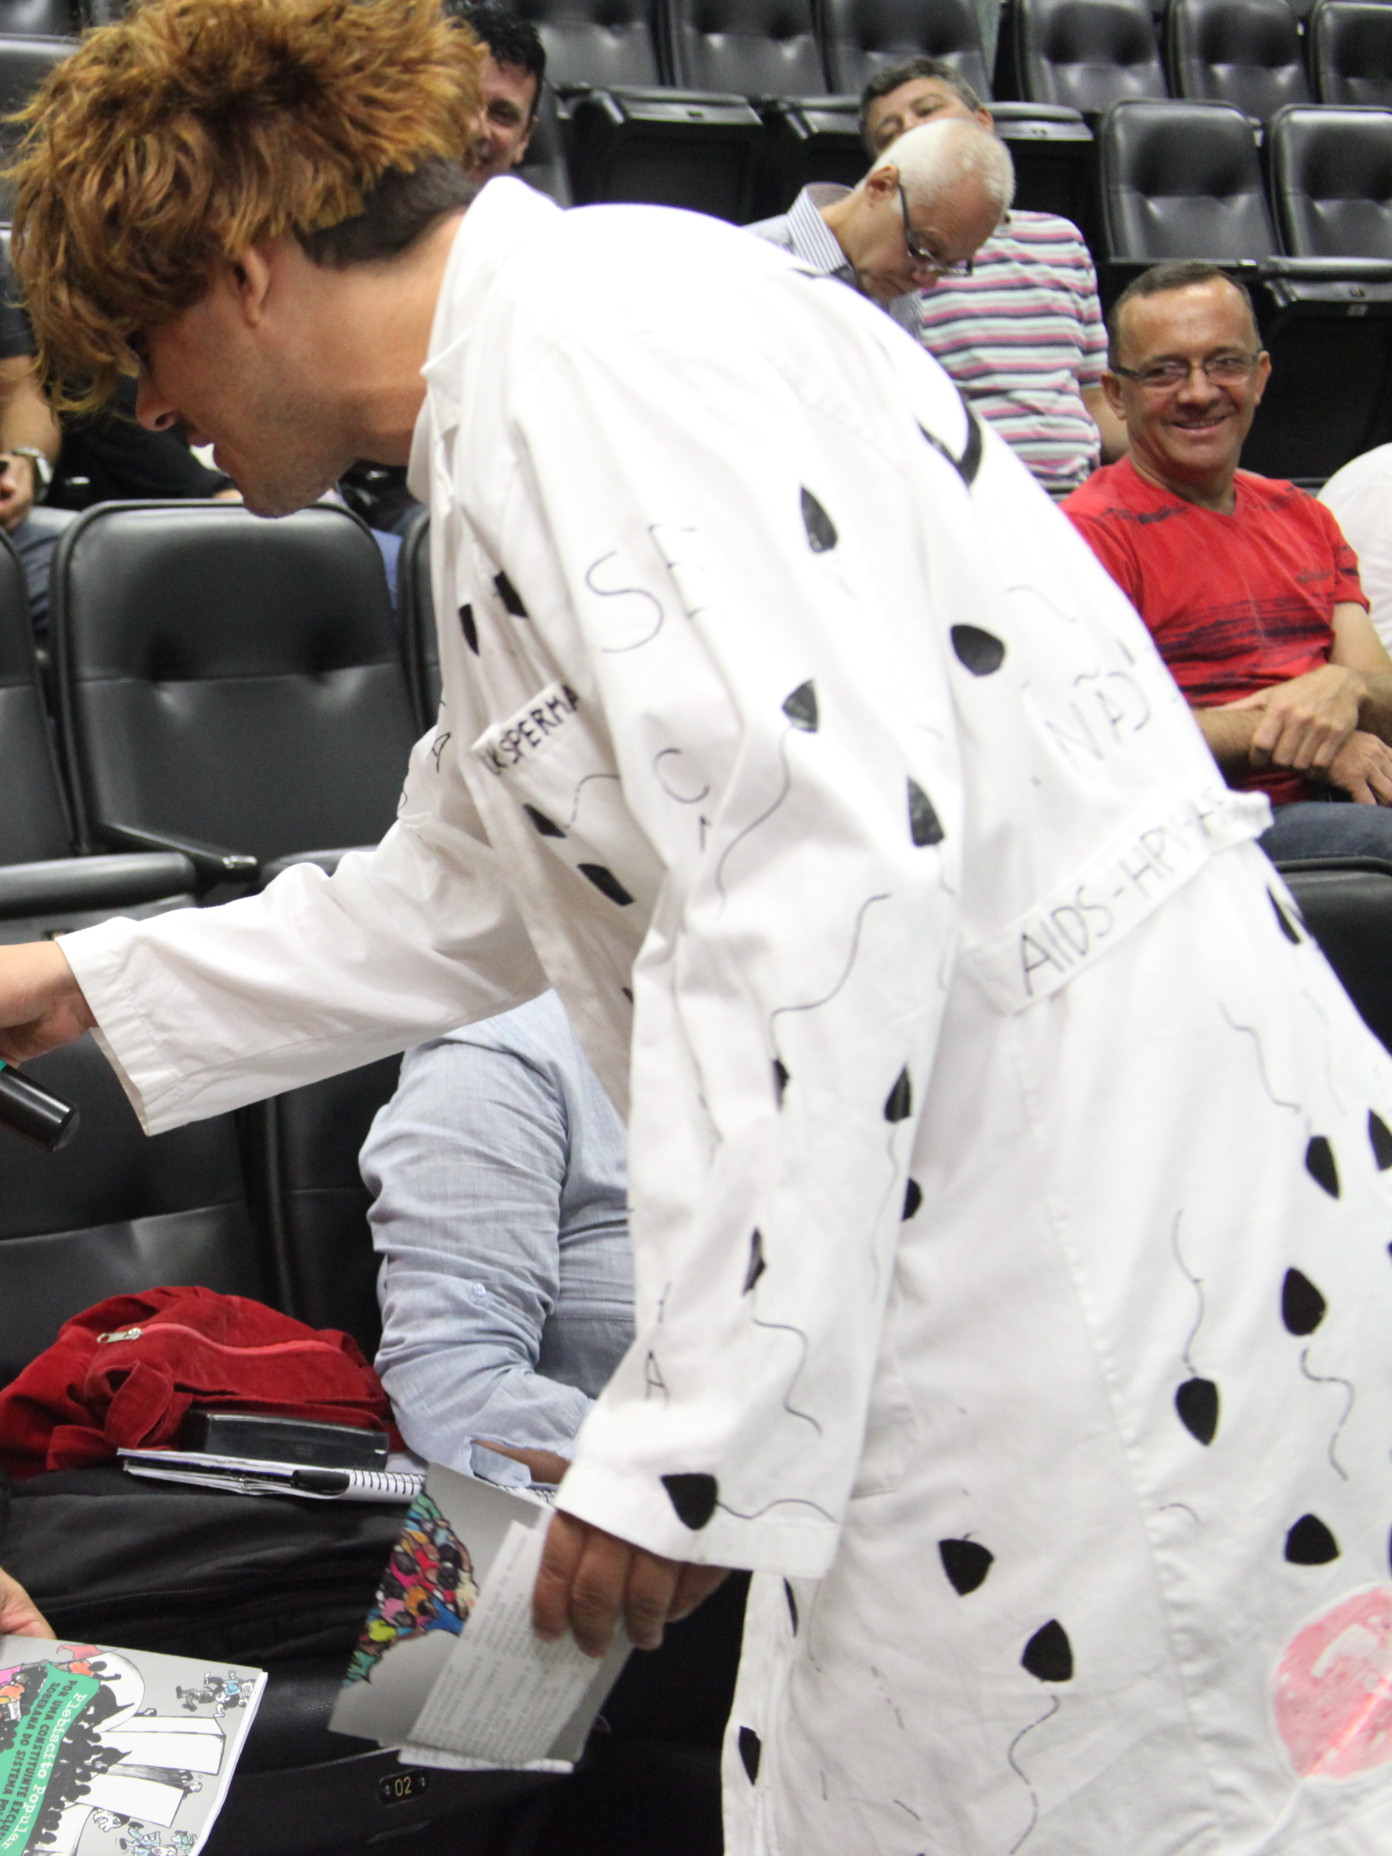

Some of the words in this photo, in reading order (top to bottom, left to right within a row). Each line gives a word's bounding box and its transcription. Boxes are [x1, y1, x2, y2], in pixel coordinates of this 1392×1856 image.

[25, 1681, 61, 1730] SOBERANA
[43, 1699, 63, 1721] UMA
[57, 1679, 78, 1697] POR
[19, 1732, 33, 1746] DO
[37, 1691, 88, 1779] Plebiscito
[2, 1749, 27, 1796] SISTEMA
[16, 1723, 50, 1798] CONSTITUINTE
[394, 1775, 412, 1797] 02
[0, 1783, 47, 1849] Popular
